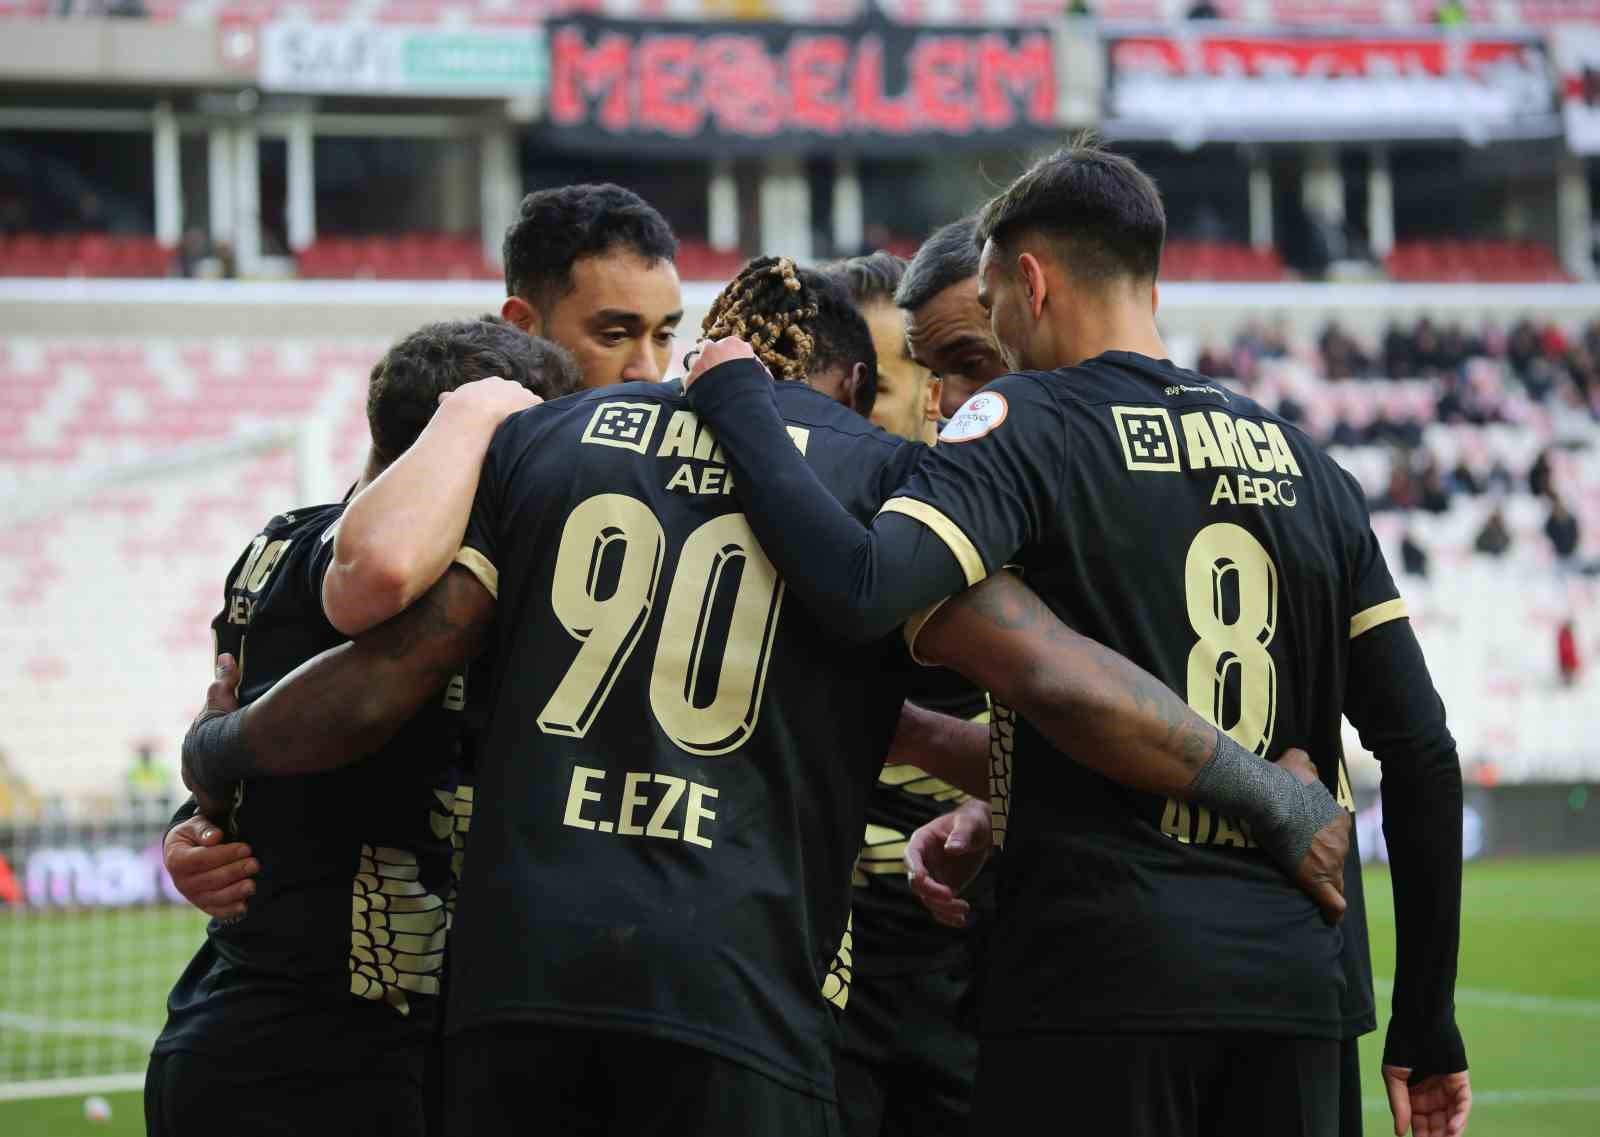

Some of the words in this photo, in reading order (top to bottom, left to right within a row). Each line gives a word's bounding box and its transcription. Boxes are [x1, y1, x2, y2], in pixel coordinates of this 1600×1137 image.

[1181, 411, 1303, 477] ARCA
[1210, 474, 1297, 507] AERO
[536, 493, 786, 756] 90
[1185, 522, 1278, 758] 8
[563, 765, 719, 849] E.EZE
